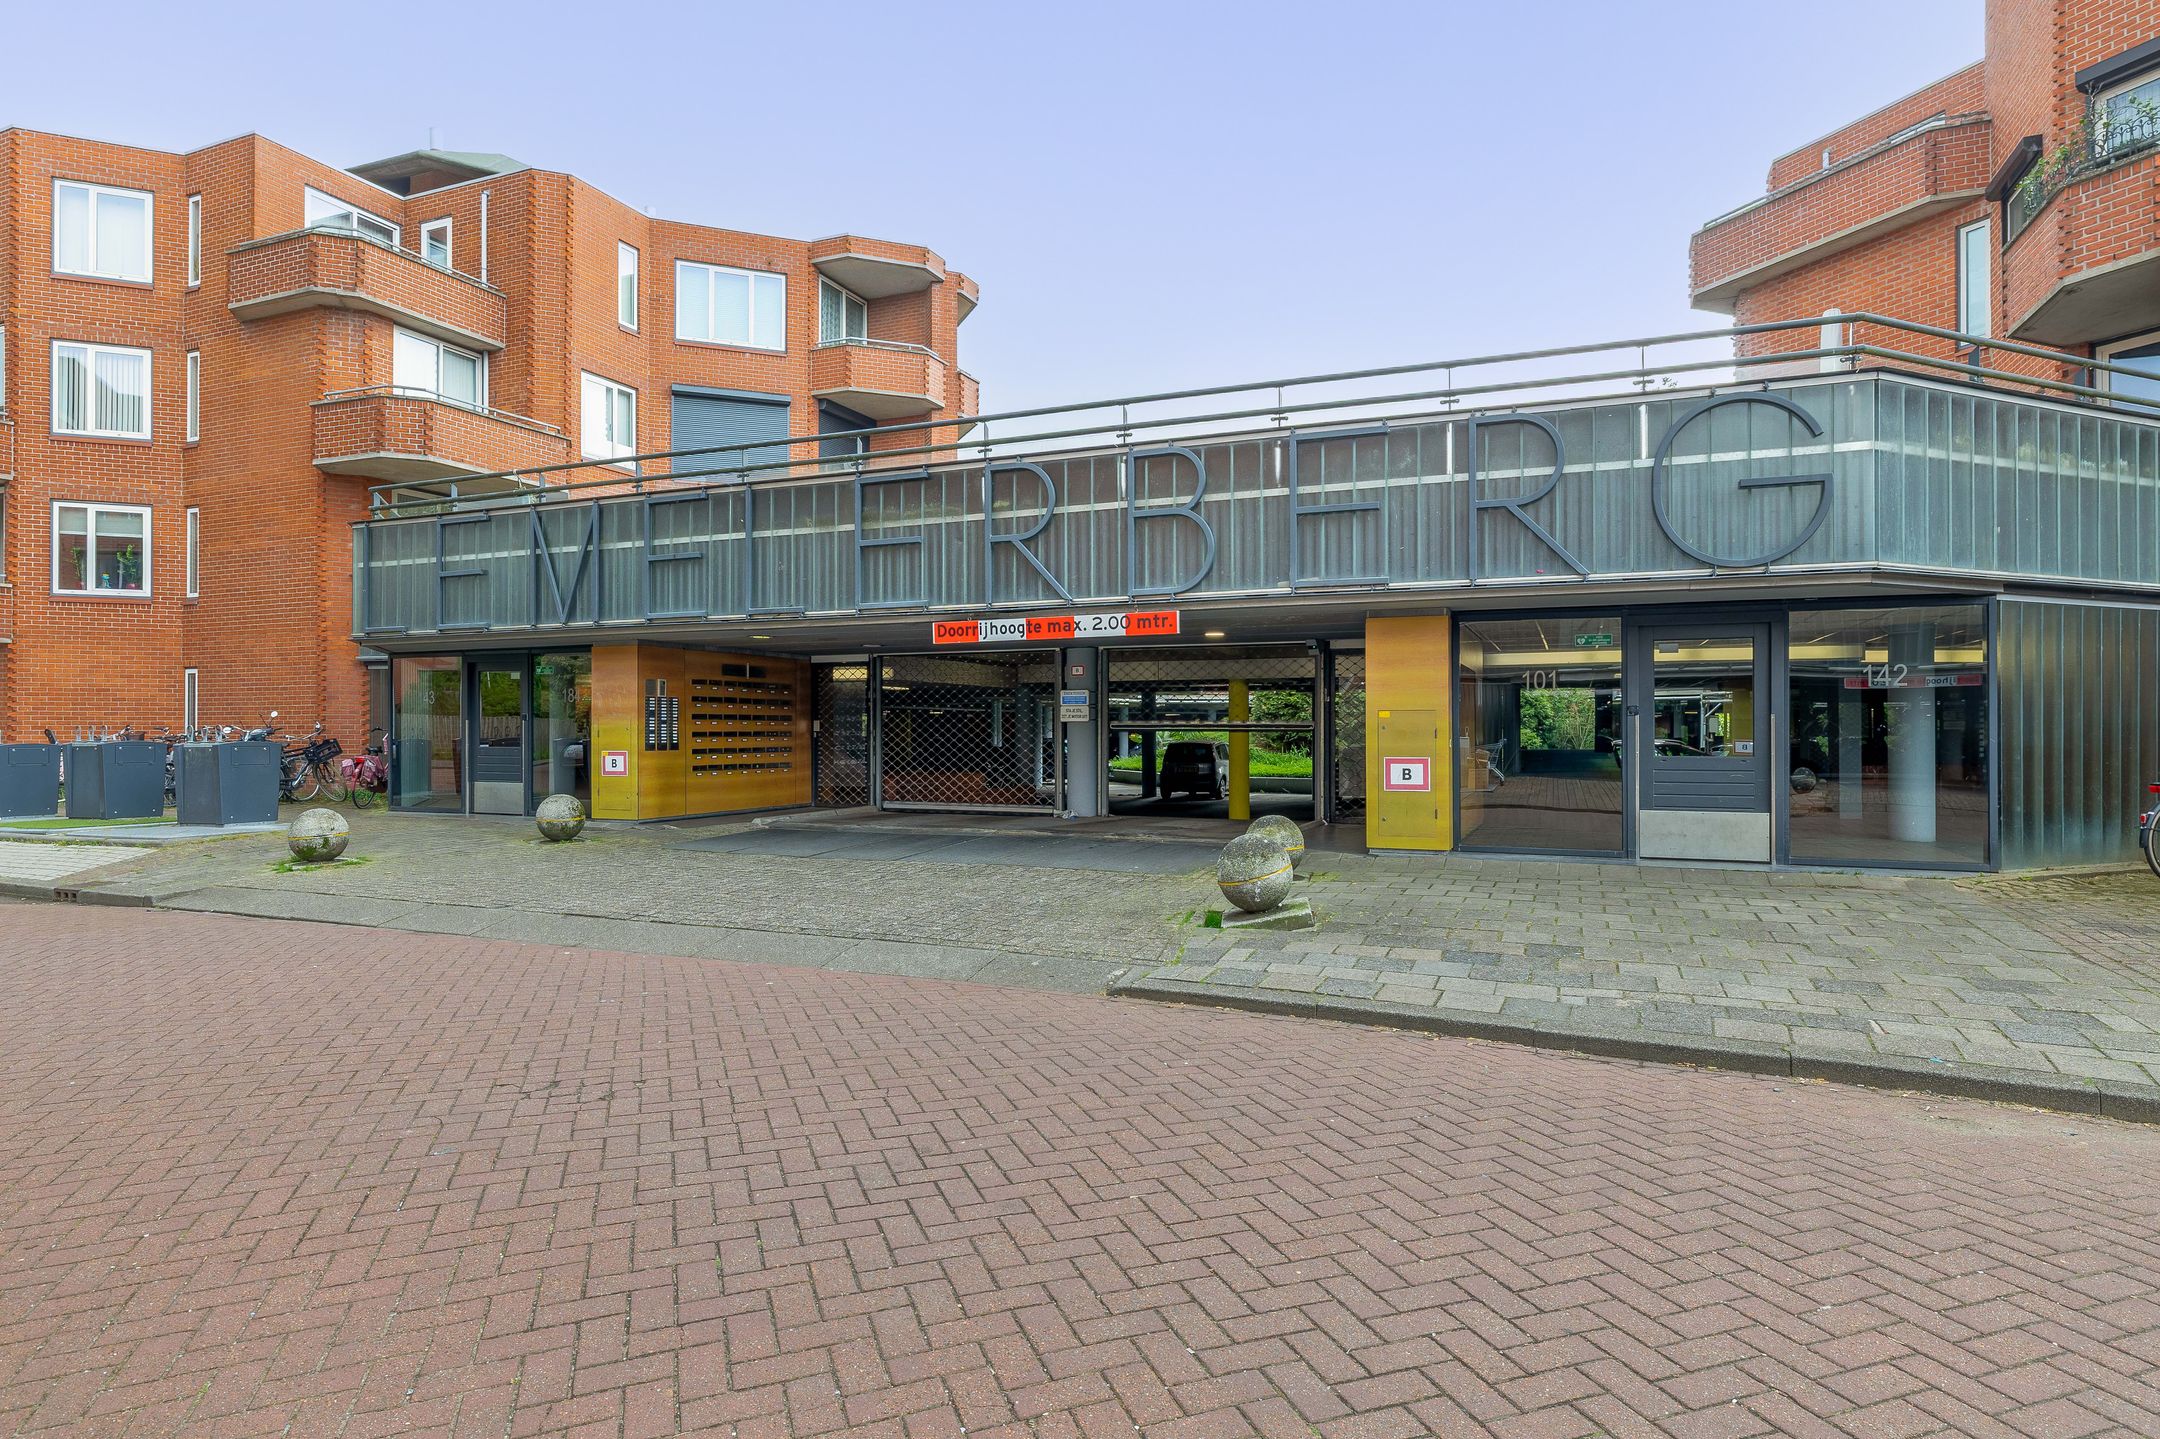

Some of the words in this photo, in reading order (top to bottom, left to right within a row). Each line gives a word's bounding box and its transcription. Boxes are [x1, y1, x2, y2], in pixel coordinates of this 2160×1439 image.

[363, 391, 1835, 633] LEMELERBERG
[937, 620, 1041, 641] Doorrijhoogte
[1047, 618, 1087, 634] max.
[1092, 616, 1131, 631] 2.00
[1137, 614, 1174, 630] mtr.
[1521, 670, 1557, 691] 101
[1862, 664, 1908, 687] 142
[611, 758, 618, 769] B
[1402, 768, 1412, 781] B
